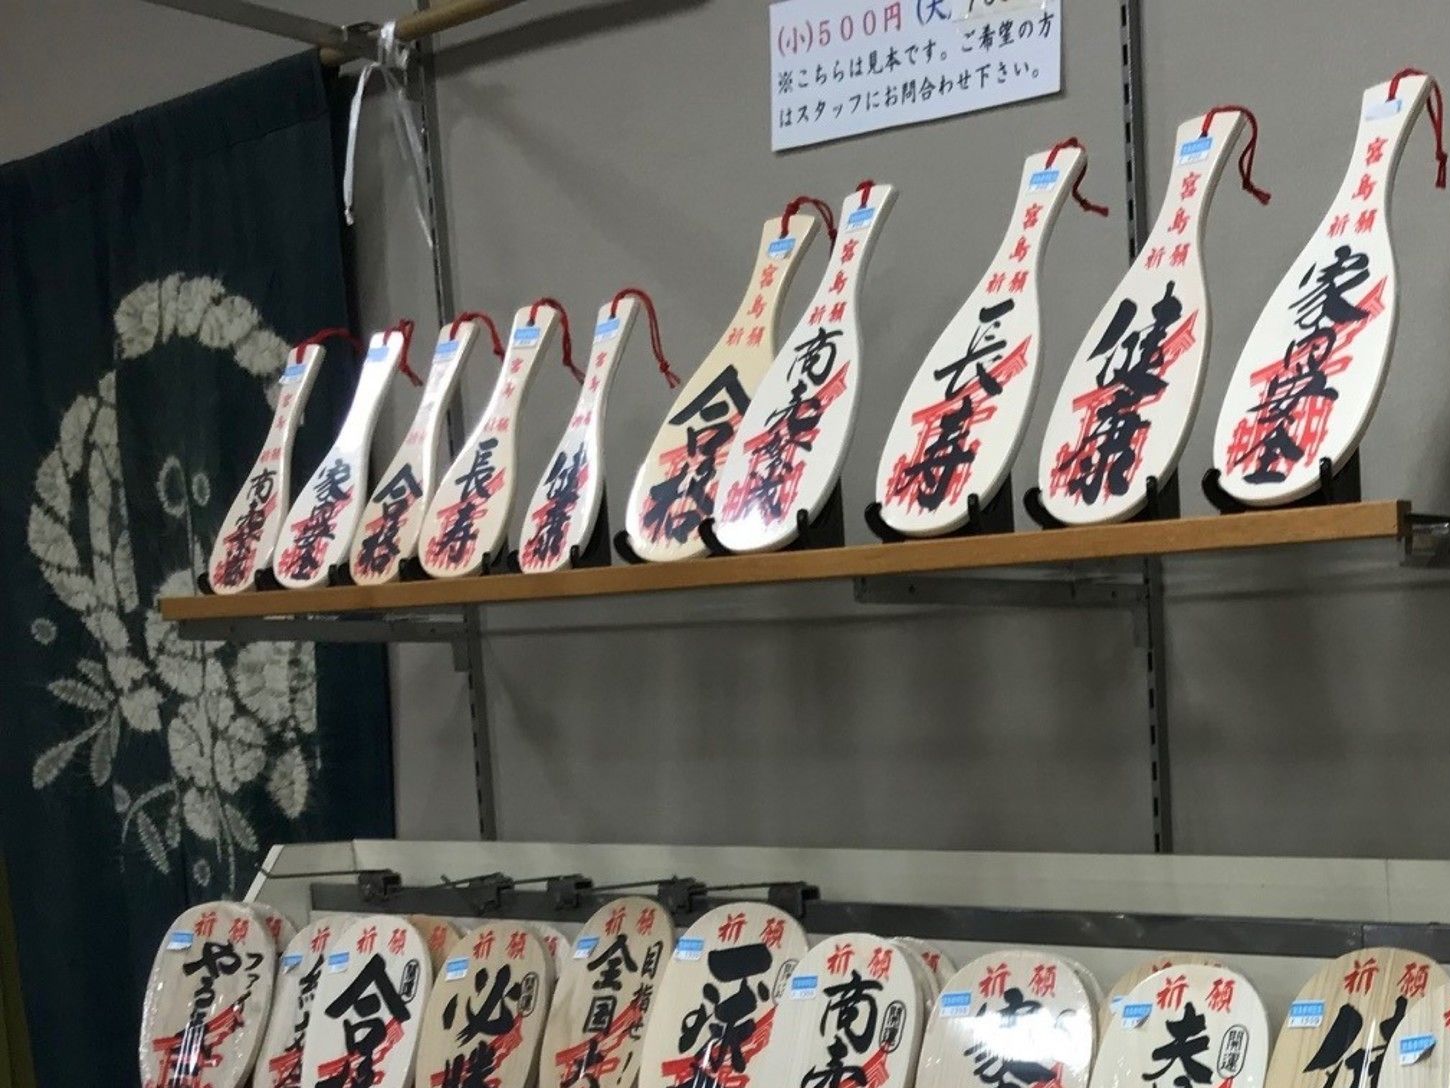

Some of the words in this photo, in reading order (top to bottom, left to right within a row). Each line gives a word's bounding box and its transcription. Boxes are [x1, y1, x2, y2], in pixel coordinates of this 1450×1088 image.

[779, 63, 1039, 127] はスタッフにお問合わせ下さい。
[1351, 137, 1389, 201] 宮島
[1167, 171, 1201, 235] 宮島
[1327, 209, 1377, 238] 祈願
[1009, 203, 1043, 262] 宮島
[829, 240, 859, 293] 宮島
[1144, 242, 1191, 269] 祈願
[986, 270, 1030, 294] 祈願
[809, 301, 847, 324] 祈願
[1234, 244, 1371, 485] 家内安全
[905, 299, 1015, 511] 長寿
[1059, 280, 1183, 504] 健康
[640, 364, 749, 541] 合格
[436, 437, 498, 564] 長寿
[532, 442, 589, 568] 健康
[357, 926, 409, 955] 祈願
[605, 906, 657, 936] 祈願
[718, 912, 787, 949] 祈願
[472, 930, 528, 960] 祈願
[827, 944, 893, 980] 祈願
[978, 963, 1057, 998] 祈願
[1156, 976, 1236, 1014] 祈願
[1344, 958, 1430, 1000] 祈願
